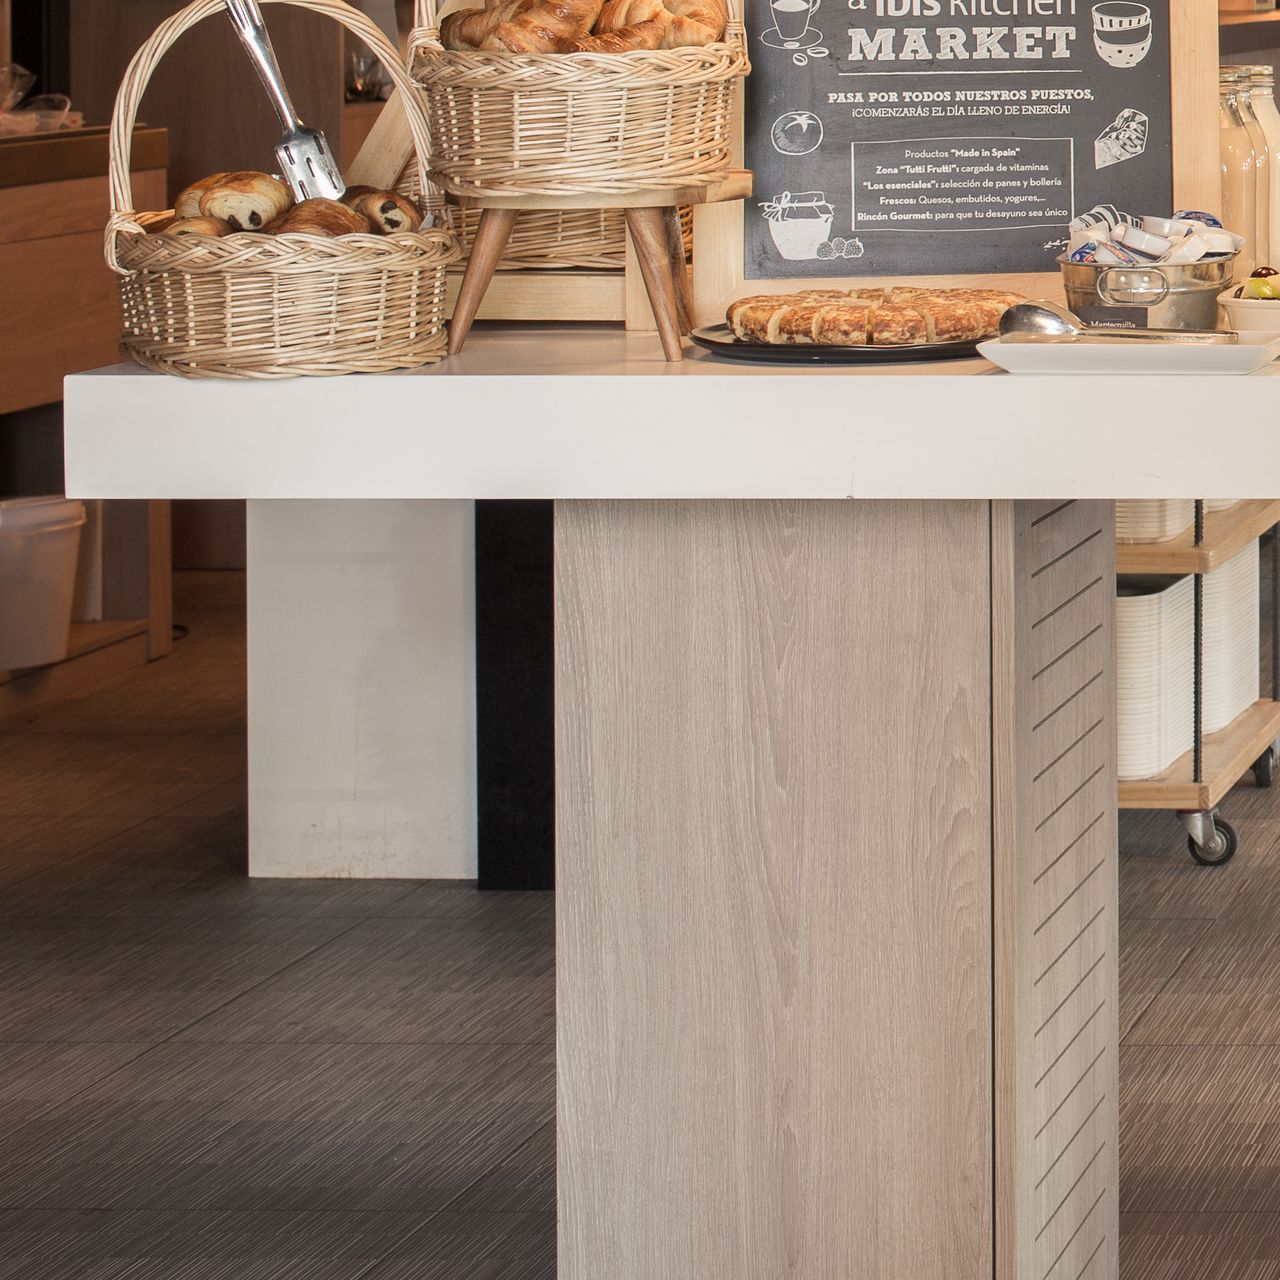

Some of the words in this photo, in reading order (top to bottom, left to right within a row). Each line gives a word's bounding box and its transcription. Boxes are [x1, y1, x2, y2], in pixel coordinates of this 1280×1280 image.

[848, 26, 1077, 61] MARKET
[828, 92, 864, 104] PASA
[869, 92, 899, 103] POR
[902, 91, 951, 103] TODOS
[955, 90, 1027, 102] NUESTROS
[1030, 89, 1094, 102] PUESTOS,
[852, 106, 930, 118] ¡COMENZARÁS
[931, 107, 945, 116] EL
[946, 104, 965, 116] DÍA
[967, 106, 1002, 116] LLENO
[1004, 106, 1020, 116] DE
[1021, 103, 1071, 115] ENERGÍA!
[905, 149, 949, 159] Productos
[981, 148, 990, 157] in
[876, 166, 898, 175] Zona
[960, 163, 995, 175] cargada
[996, 163, 1008, 172] de
[1009, 162, 1049, 172] vitaminas
[940, 178, 981, 188] selección
[982, 178, 994, 187] de
[995, 180, 1021, 190] panes
[1022, 181, 1028, 189] y
[1030, 177, 1062, 187] bollería
[880, 196, 917, 205] Frescos:
[918, 195, 954, 206] Quesos,
[955, 194, 1002, 204] embutidos,
[857, 211, 889, 221] Rincón
[890, 210, 933, 221] Gourmet:
[935, 212, 954, 222] para
[955, 212, 973, 221] que
[975, 210, 984, 219] tu
[985, 208, 1027, 221] desayuno
[1028, 210, 1042, 218] sea
[1044, 207, 1068, 217] único
